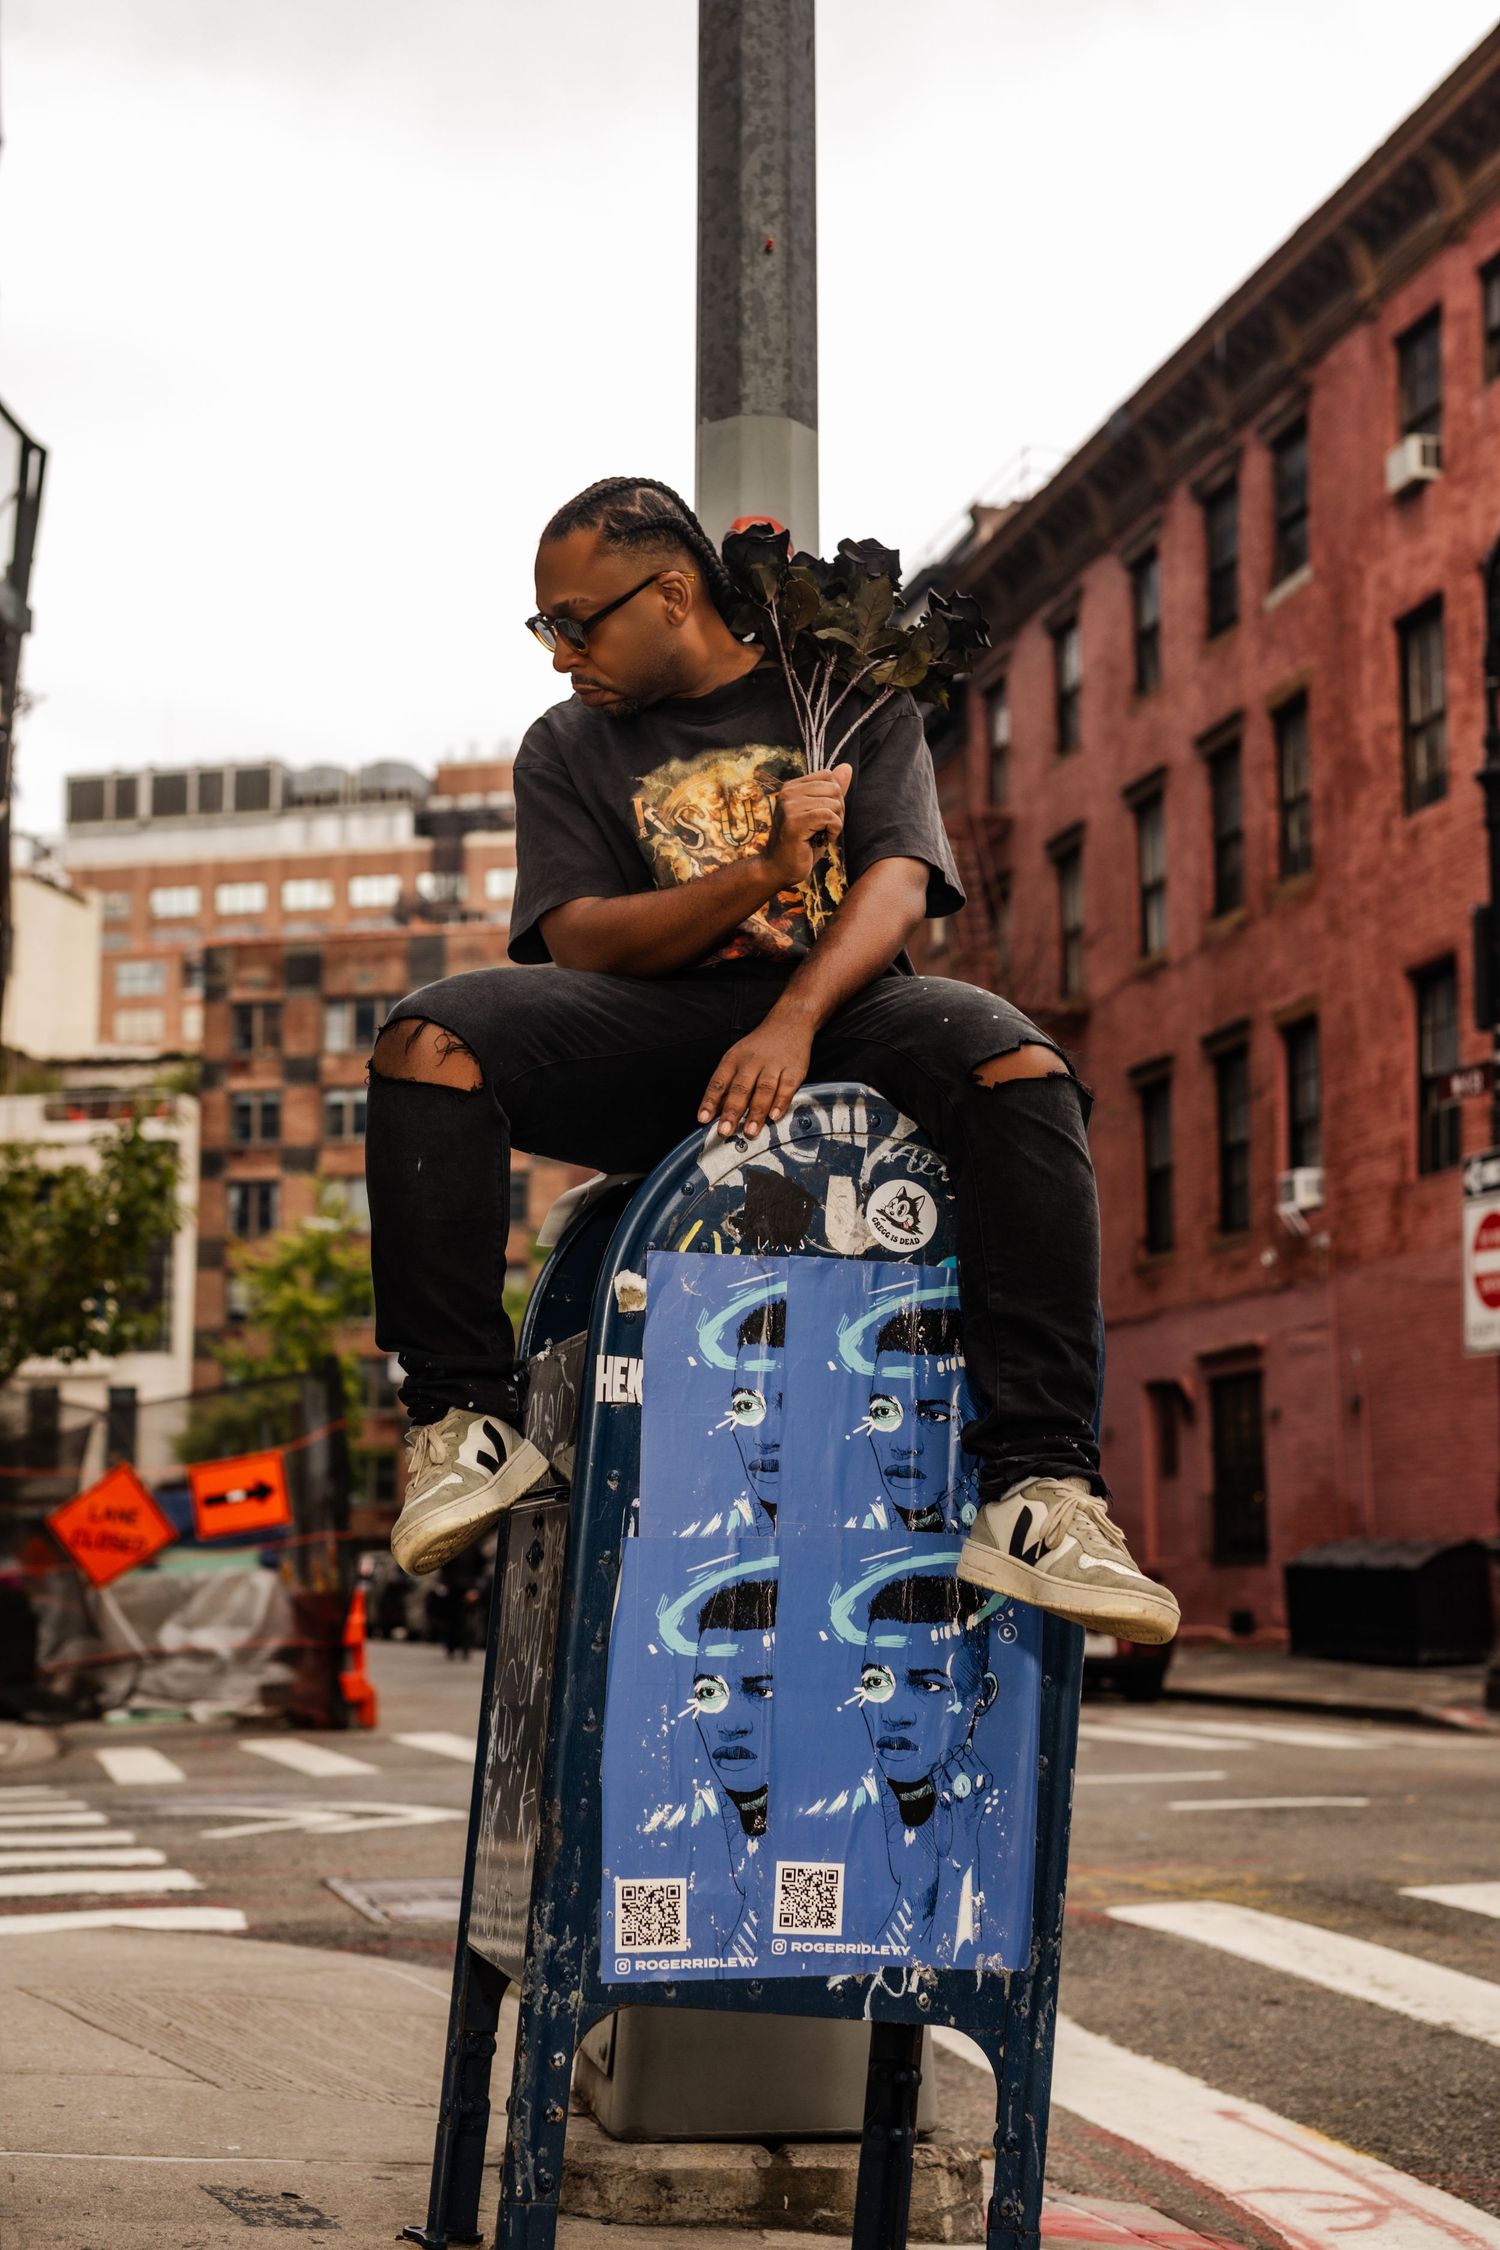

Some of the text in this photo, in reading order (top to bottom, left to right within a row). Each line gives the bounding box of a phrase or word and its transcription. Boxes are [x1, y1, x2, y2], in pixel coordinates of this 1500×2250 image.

[871, 1216, 921, 1246] GREGG IS DEAD
